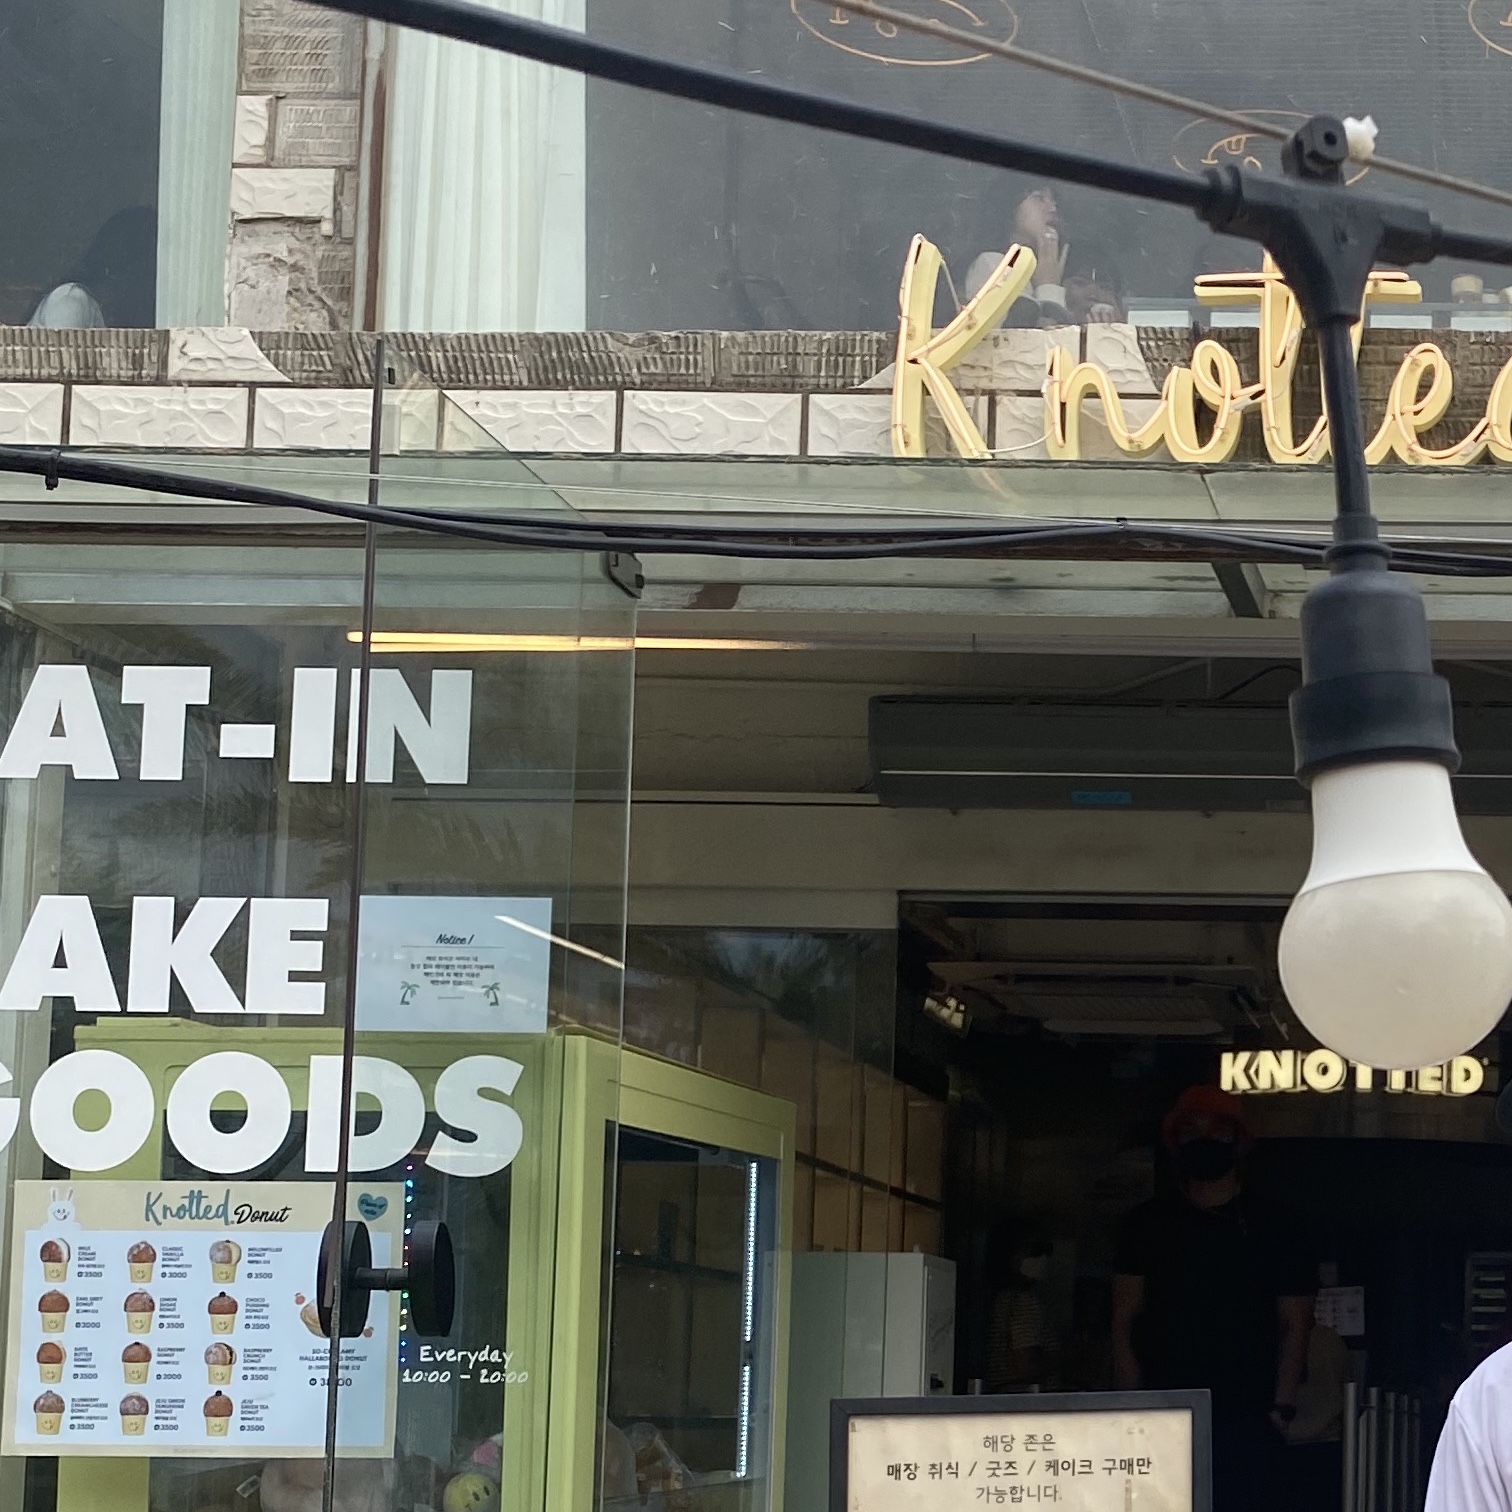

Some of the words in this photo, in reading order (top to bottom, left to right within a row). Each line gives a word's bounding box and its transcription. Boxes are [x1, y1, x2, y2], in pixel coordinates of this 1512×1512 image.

[0, 1050, 524, 1177] OODS
[144, 1189, 231, 1226] Knotted
[233, 1203, 292, 1225] Donut
[420, 1345, 514, 1369] Everyday
[320, 1378, 352, 1386] 300
[402, 1369, 451, 1383] 10:00
[480, 1369, 529, 1384] 20:00
[983, 1434, 1015, 1452] 해당
[1022, 1433, 1056, 1452] 존은
[886, 1462, 919, 1481] 매장
[928, 1460, 960, 1480] 취식
[985, 1459, 1019, 1478] 굿즈
[1045, 1458, 1094, 1477] 케이크
[1102, 1457, 1152, 1476] 구매만
[976, 1484, 1063, 1504] 가능합니다.
